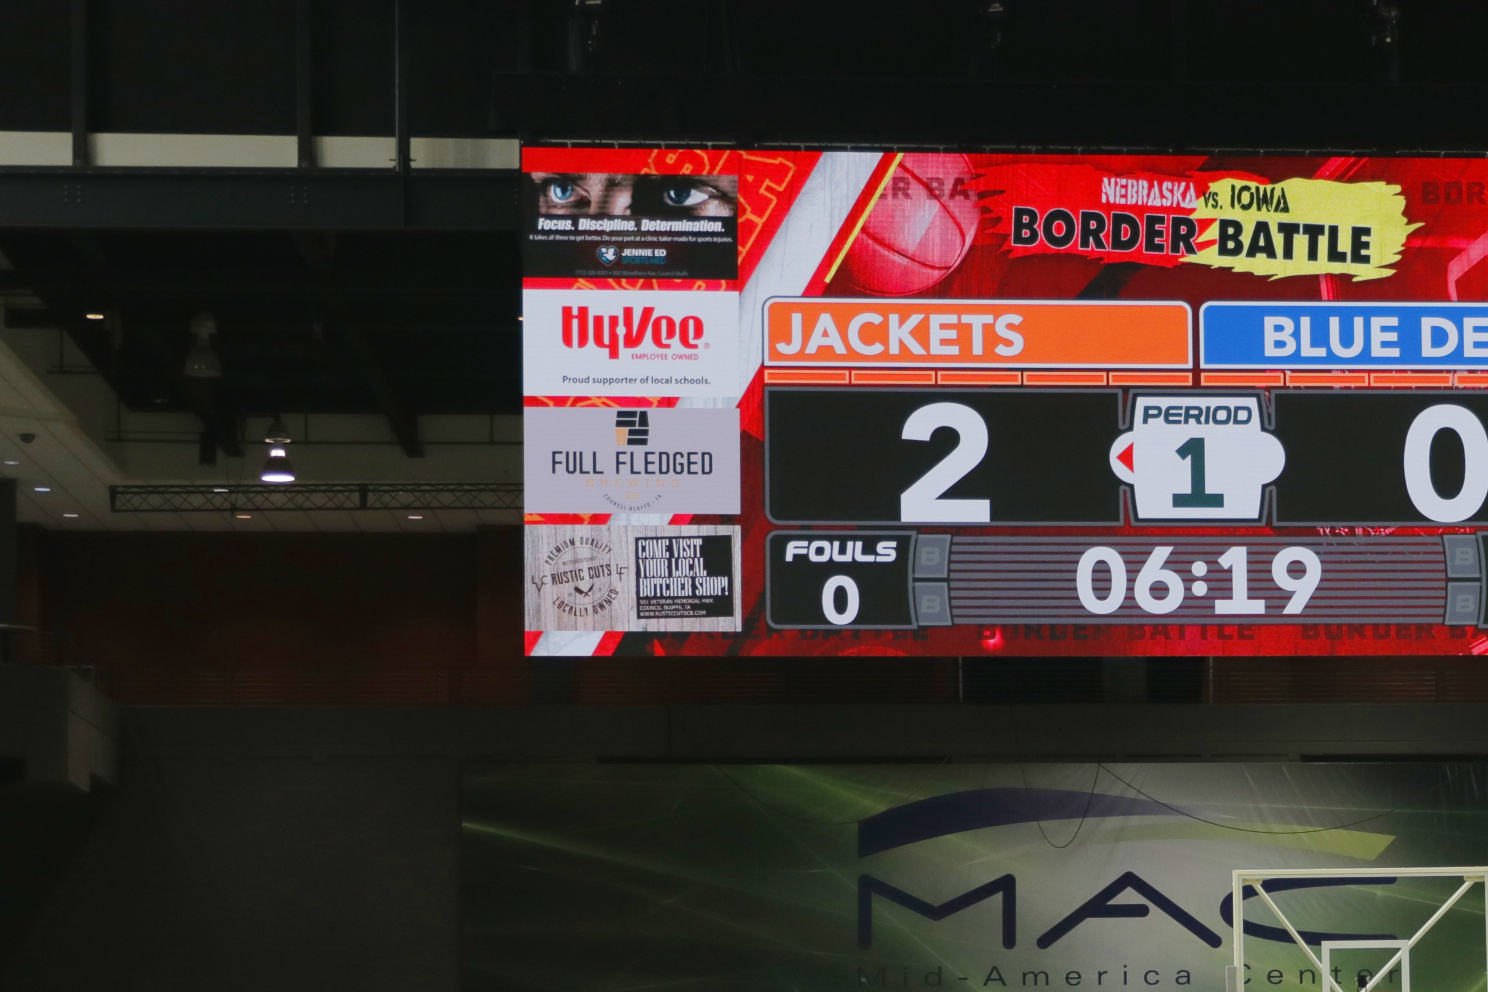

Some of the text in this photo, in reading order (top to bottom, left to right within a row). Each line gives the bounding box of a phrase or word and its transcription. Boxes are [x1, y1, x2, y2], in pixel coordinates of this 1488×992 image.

[1101, 177, 1198, 209] NEBRASKA
[1230, 184, 1290, 213] IOWA
[538, 218, 725, 232] Focus. Discipline. Determination.
[1012, 206, 1371, 265] BORDER BATTLE
[622, 249, 666, 257] JENNIE ED
[775, 312, 1025, 356] JACKETS
[1263, 316, 1400, 359] BLUE
[562, 375, 711, 386] Proud supporter of local schools.
[1142, 405, 1252, 425] PERIOD
[551, 451, 713, 475] FULL FLEDGED
[900, 402, 990, 522] 2
[1172, 437, 1224, 508] 1
[585, 478, 680, 488] BREWING
[603, 493, 627, 511] COUNCIL
[629, 502, 651, 512] BLUFFS
[545, 536, 612, 565] PREMIUM QUALITY
[638, 538, 702, 558] COME VISIT
[785, 541, 897, 563] FOULS
[551, 564, 612, 586] RUSTIC CUTS
[639, 558, 707, 577] YOUR LOCAL
[640, 576, 728, 597] BUTCHER SHOP!
[1076, 546, 1322, 615] 06:19
[553, 588, 619, 617] LOCALLY OWNED
[821, 575, 860, 625] 0
[858, 871, 1397, 950] MAC
[857, 964, 1192, 988] Mid-America
